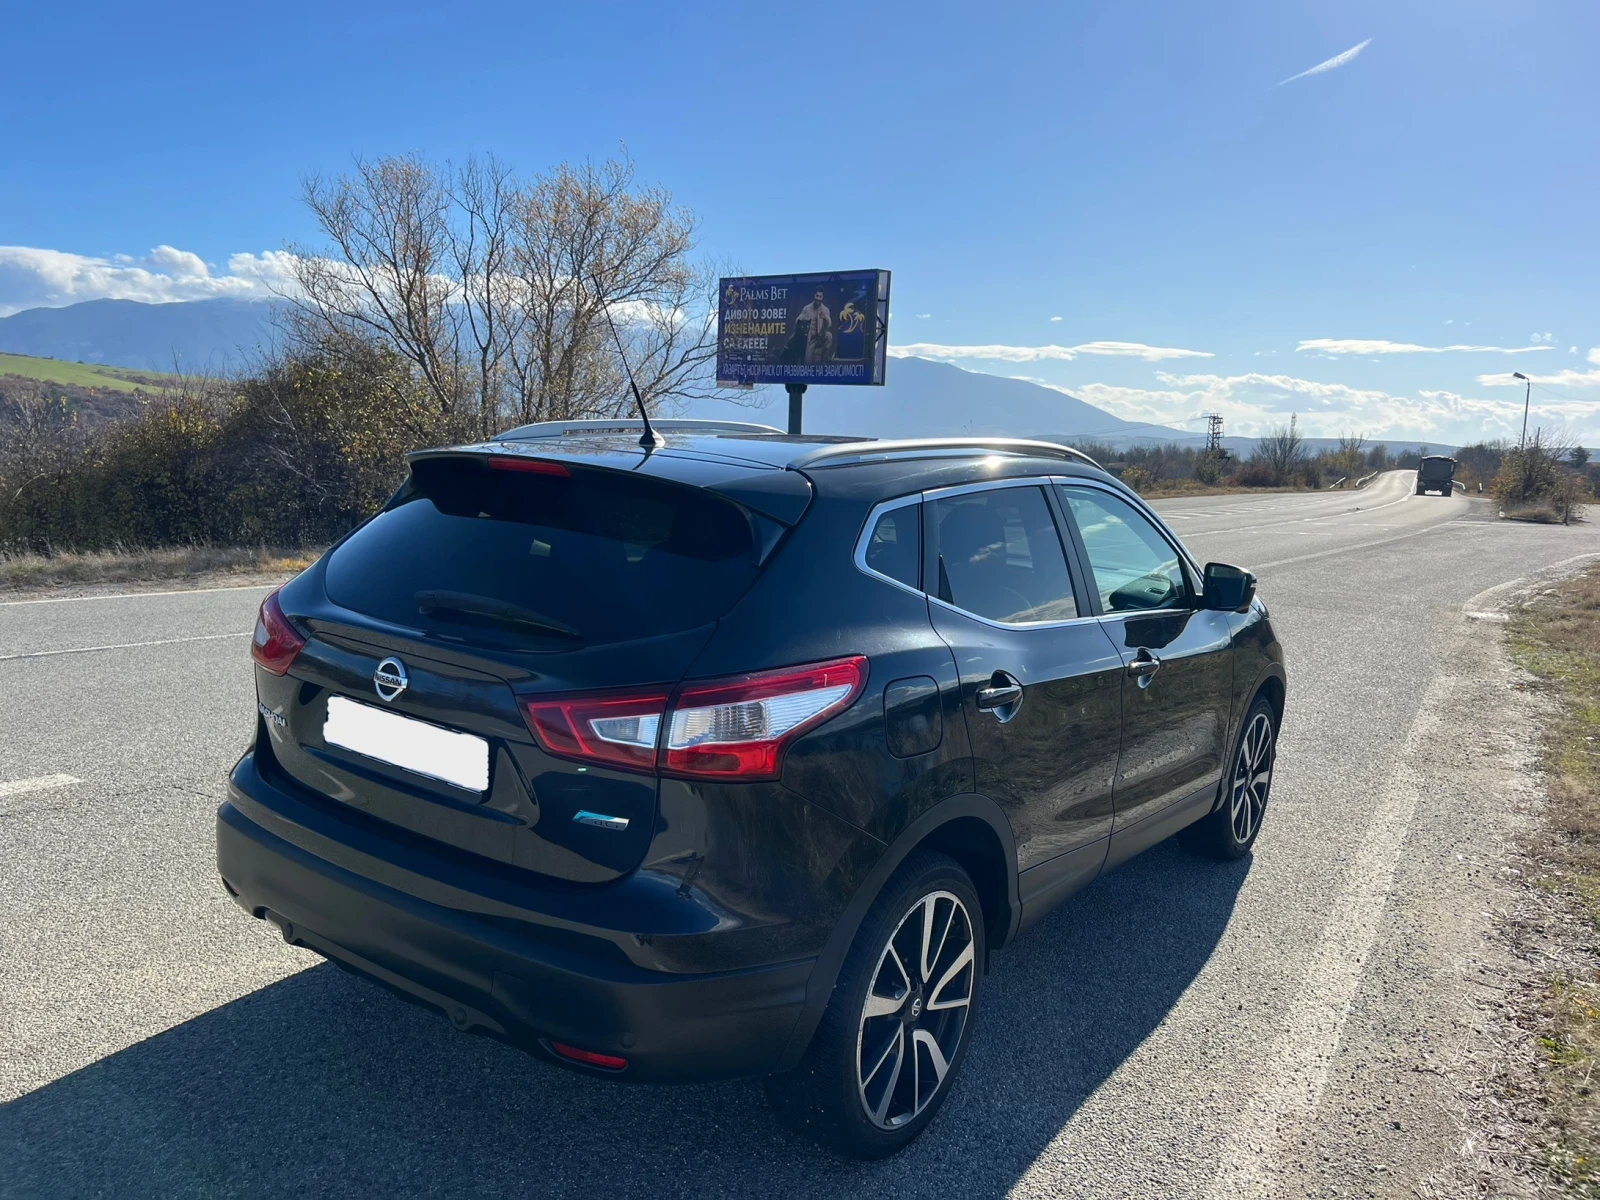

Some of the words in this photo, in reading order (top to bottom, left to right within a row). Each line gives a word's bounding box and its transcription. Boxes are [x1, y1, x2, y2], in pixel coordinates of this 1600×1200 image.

[740, 287, 769, 302] PALMS
[770, 286, 788, 301] BET
[724, 308, 759, 321] ДИВОТО
[760, 308, 787, 319] ЗОВЕ!
[724, 322, 786, 336] ИЗНЕНАДИТЕ
[762, 364, 776, 376] РИСК
[776, 364, 784, 377] ОТ
[816, 364, 824, 377] НА
[375, 671, 402, 687] NISSAN
